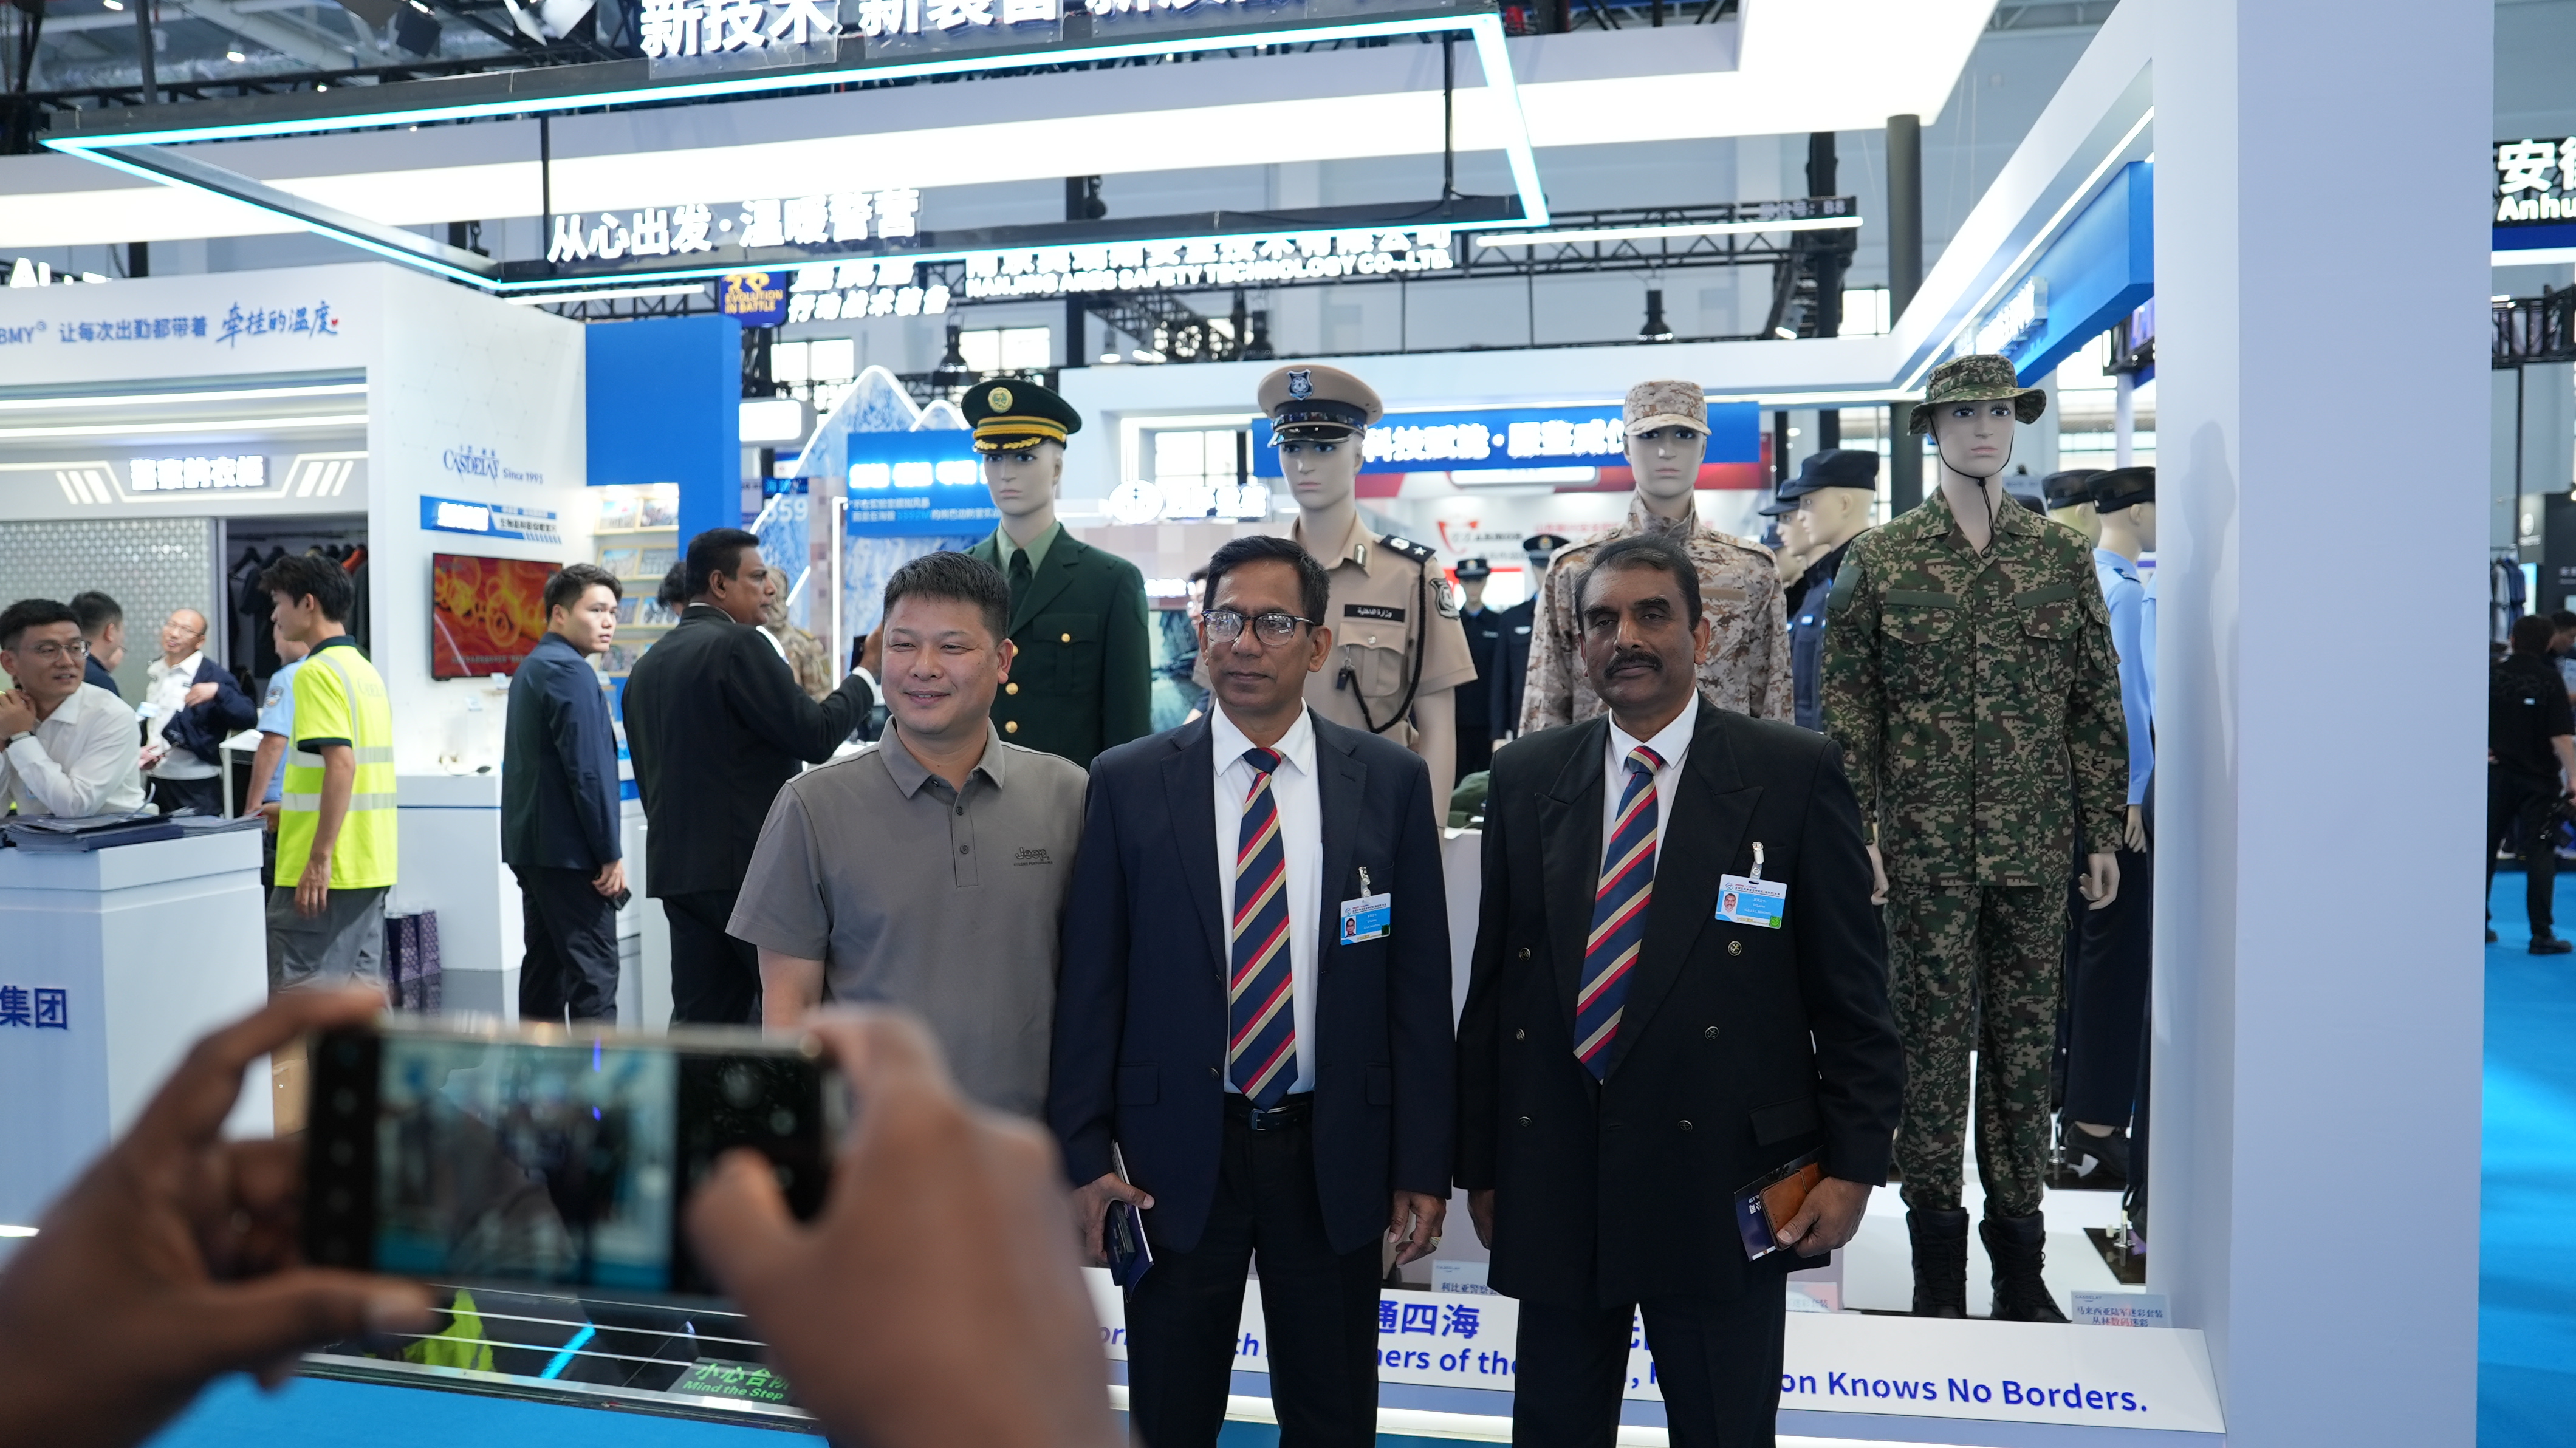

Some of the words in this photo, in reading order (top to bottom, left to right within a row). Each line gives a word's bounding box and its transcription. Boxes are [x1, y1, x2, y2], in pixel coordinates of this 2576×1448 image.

[640, 0, 835, 57] 新技术
[547, 189, 918, 264] 从心出发·温暖警营
[1118, 264, 1203, 290] SAFETY
[1203, 254, 1357, 284] TECHNOLOGY
[725, 289, 783, 304] EVOLUTION
[738, 300, 776, 313] BATTLE
[1015, 847, 1047, 861] Jeep
[0, 985, 67, 1030] 集团
[2077, 1306, 2164, 1319] 马来西亚陆军迷彩套装
[1439, 1348, 1471, 1373] of
[1478, 1350, 1516, 1376] th
[682, 1380, 724, 1393] Mind
[722, 1385, 748, 1396] the
[748, 1387, 784, 1401] Step
[1828, 1371, 1937, 1401] Knows
[1948, 1378, 1992, 1404] No
[2002, 1379, 2148, 1412] Borders.
